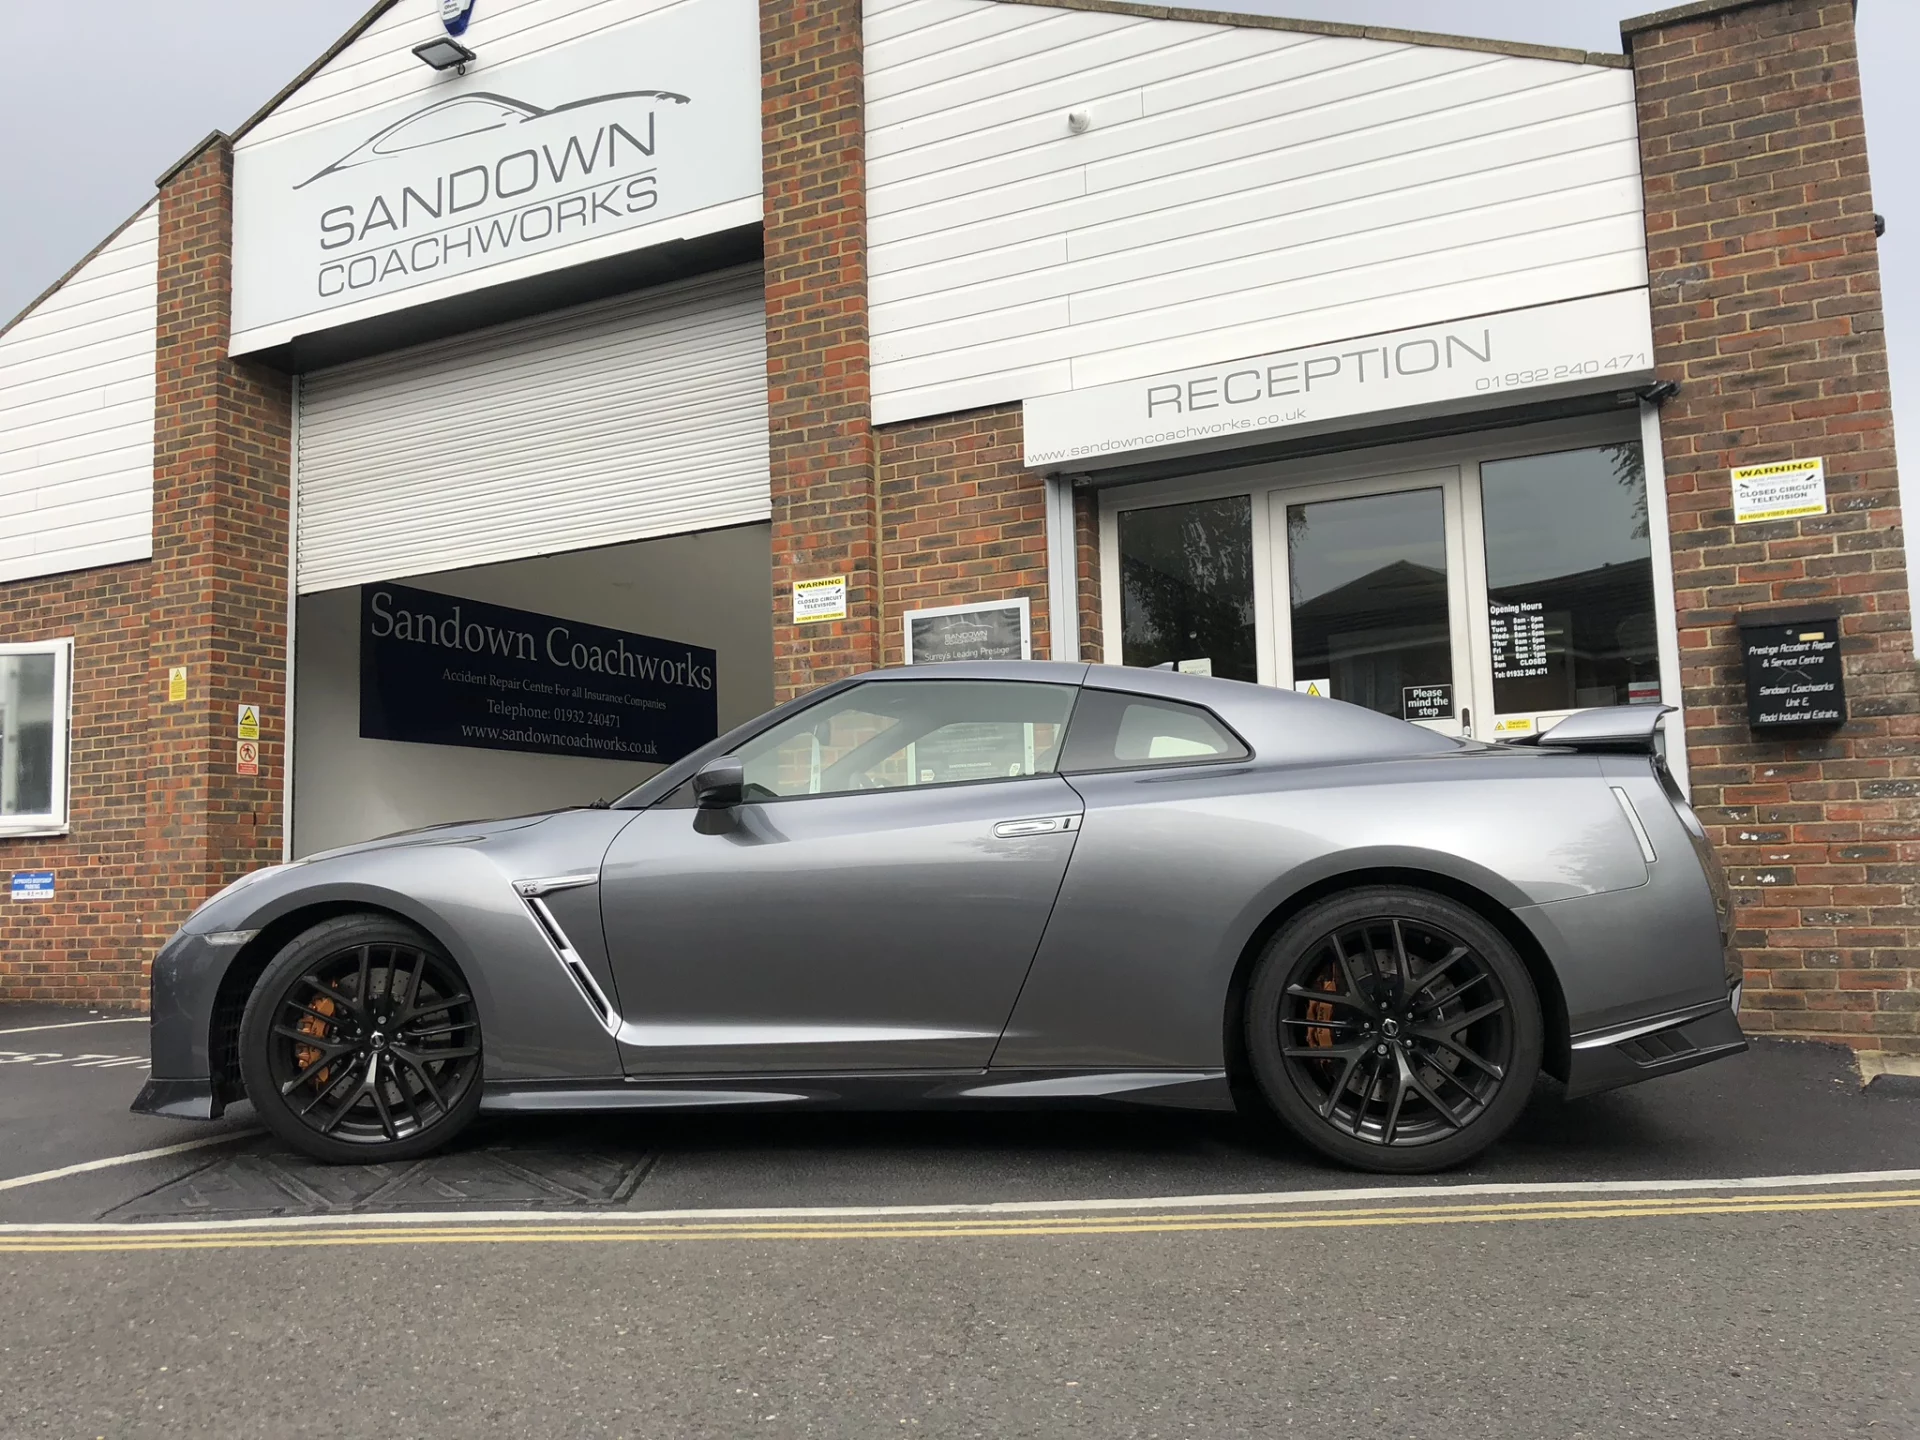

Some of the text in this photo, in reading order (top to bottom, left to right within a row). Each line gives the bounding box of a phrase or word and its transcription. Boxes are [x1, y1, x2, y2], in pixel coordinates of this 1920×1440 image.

[320, 111, 655, 251] SANDOWN
[318, 175, 658, 298] COACHWORKS
[1147, 329, 1490, 419] RECEPTION
[1475, 352, 1648, 391] 01932 240 471
[1027, 407, 1308, 464] www.sandowncoachworks.co.uk
[1740, 461, 1815, 477] WARNING
[1740, 488, 1777, 498] CLOSED
[1779, 482, 1818, 494] CIRCUIT
[1751, 491, 1808, 504] TELEVISION
[797, 578, 841, 589] WARNING
[803, 601, 837, 610] TELEVISION
[819, 594, 843, 603] CIRCUIT
[1490, 602, 1543, 615] Opening Hours
[371, 591, 712, 691] Sandown Coachworks
[1748, 640, 1836, 656] Prestige Accident Repair
[925, 650, 951, 662] Surrey's
[952, 649, 978, 660] Leading
[980, 646, 1010, 657] Prestige
[1494, 658, 1547, 669] Sun CLOSED
[1762, 655, 1824, 668] & Service Centre
[1506, 669, 1524, 678] 01932
[1525, 668, 1536, 676] 240
[1537, 667, 1548, 675] 471
[443, 667, 667, 712] Accident Repair Centre For all Insurance Companies
[1413, 689, 1443, 698] Please
[1760, 682, 1835, 696] Sandown Coachworks
[1407, 696, 1449, 708] mind the
[1786, 698, 1800, 708] Unit
[487, 699, 621, 729] Telephone: 01932 240471
[1418, 707, 1439, 717] step
[1760, 713, 1778, 723] Rodd
[1778, 710, 1812, 721] Industrial
[461, 724, 658, 756] www.sandowncoachworks.co.uk
